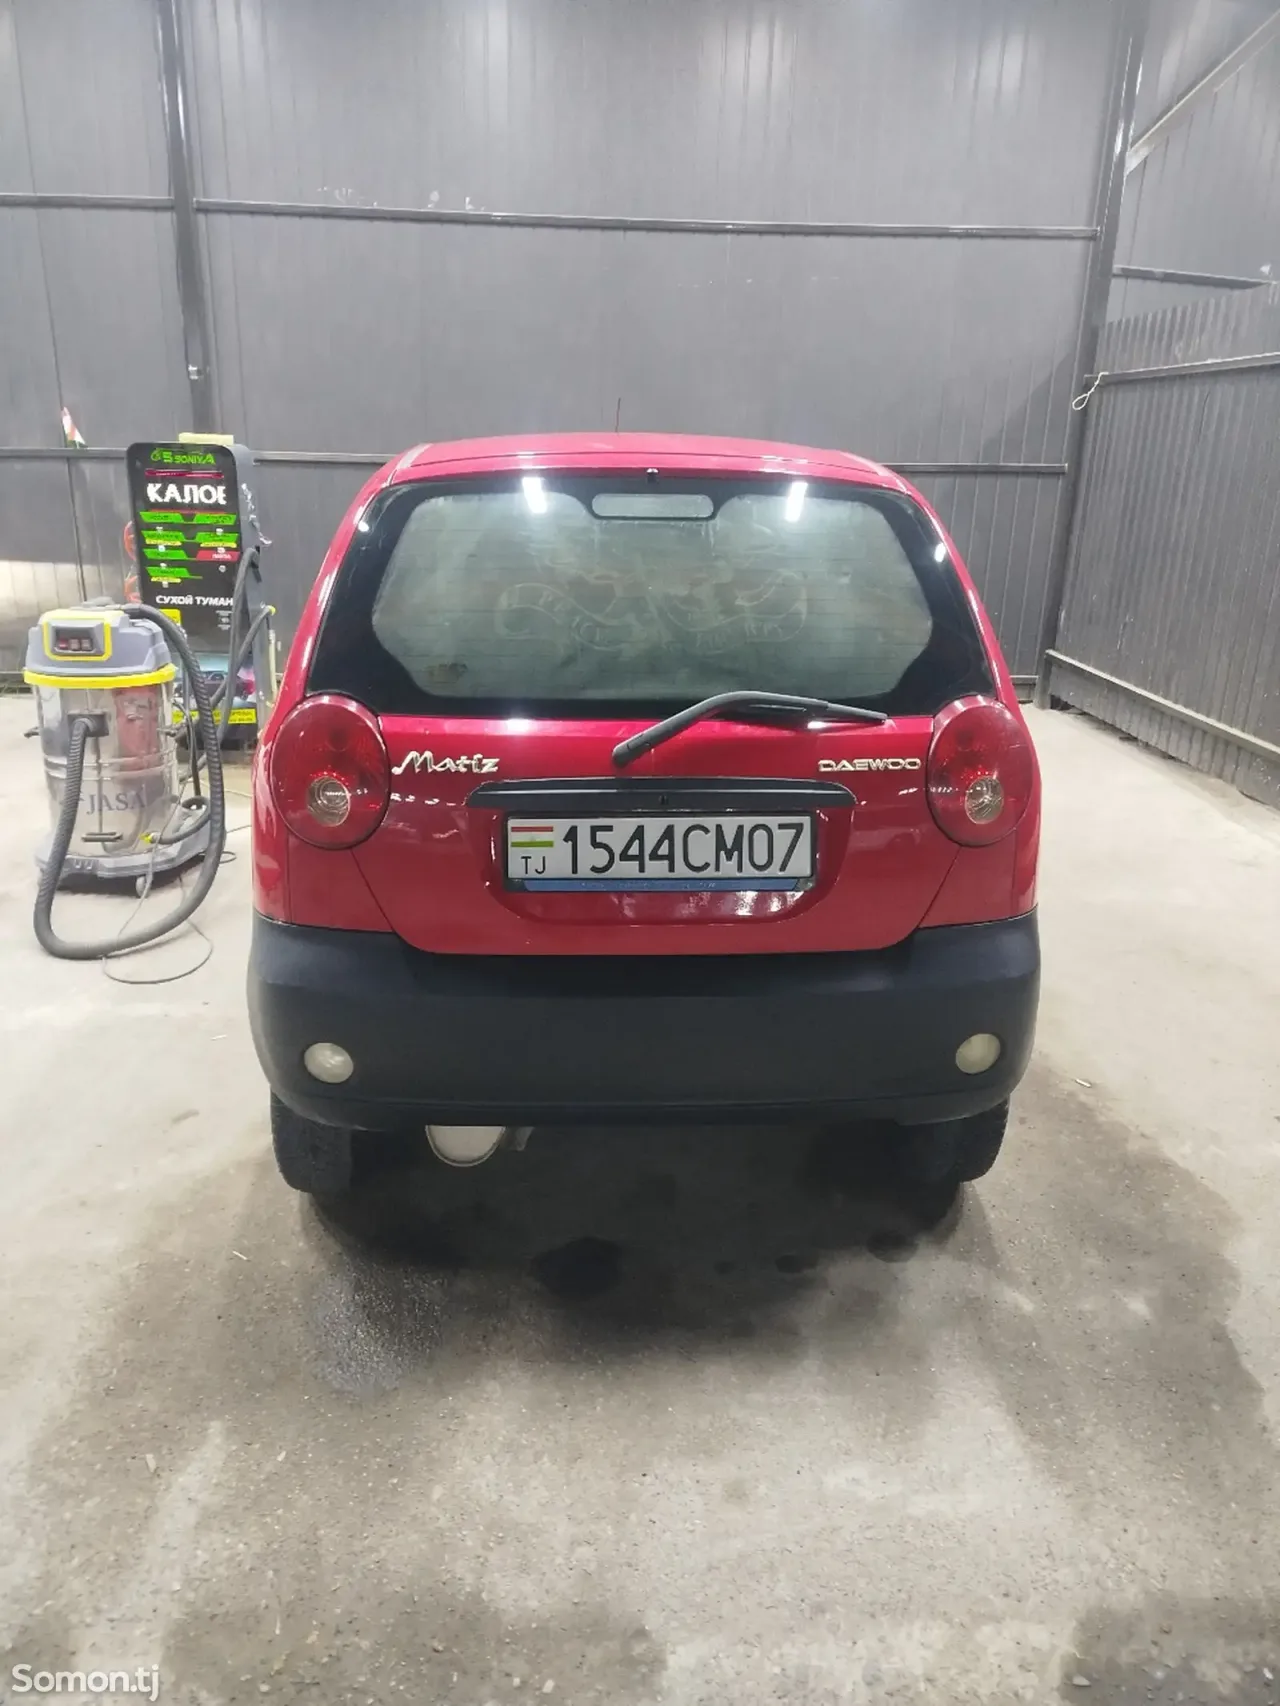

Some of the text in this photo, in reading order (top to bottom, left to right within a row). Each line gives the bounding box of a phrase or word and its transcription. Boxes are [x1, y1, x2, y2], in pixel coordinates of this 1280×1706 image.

[155, 594, 234, 607] СУХОЙ ТУМАН
[391, 750, 500, 775] Matiz
[818, 758, 922, 773] DAEWOO
[520, 822, 805, 876] TJ 1544CM07
